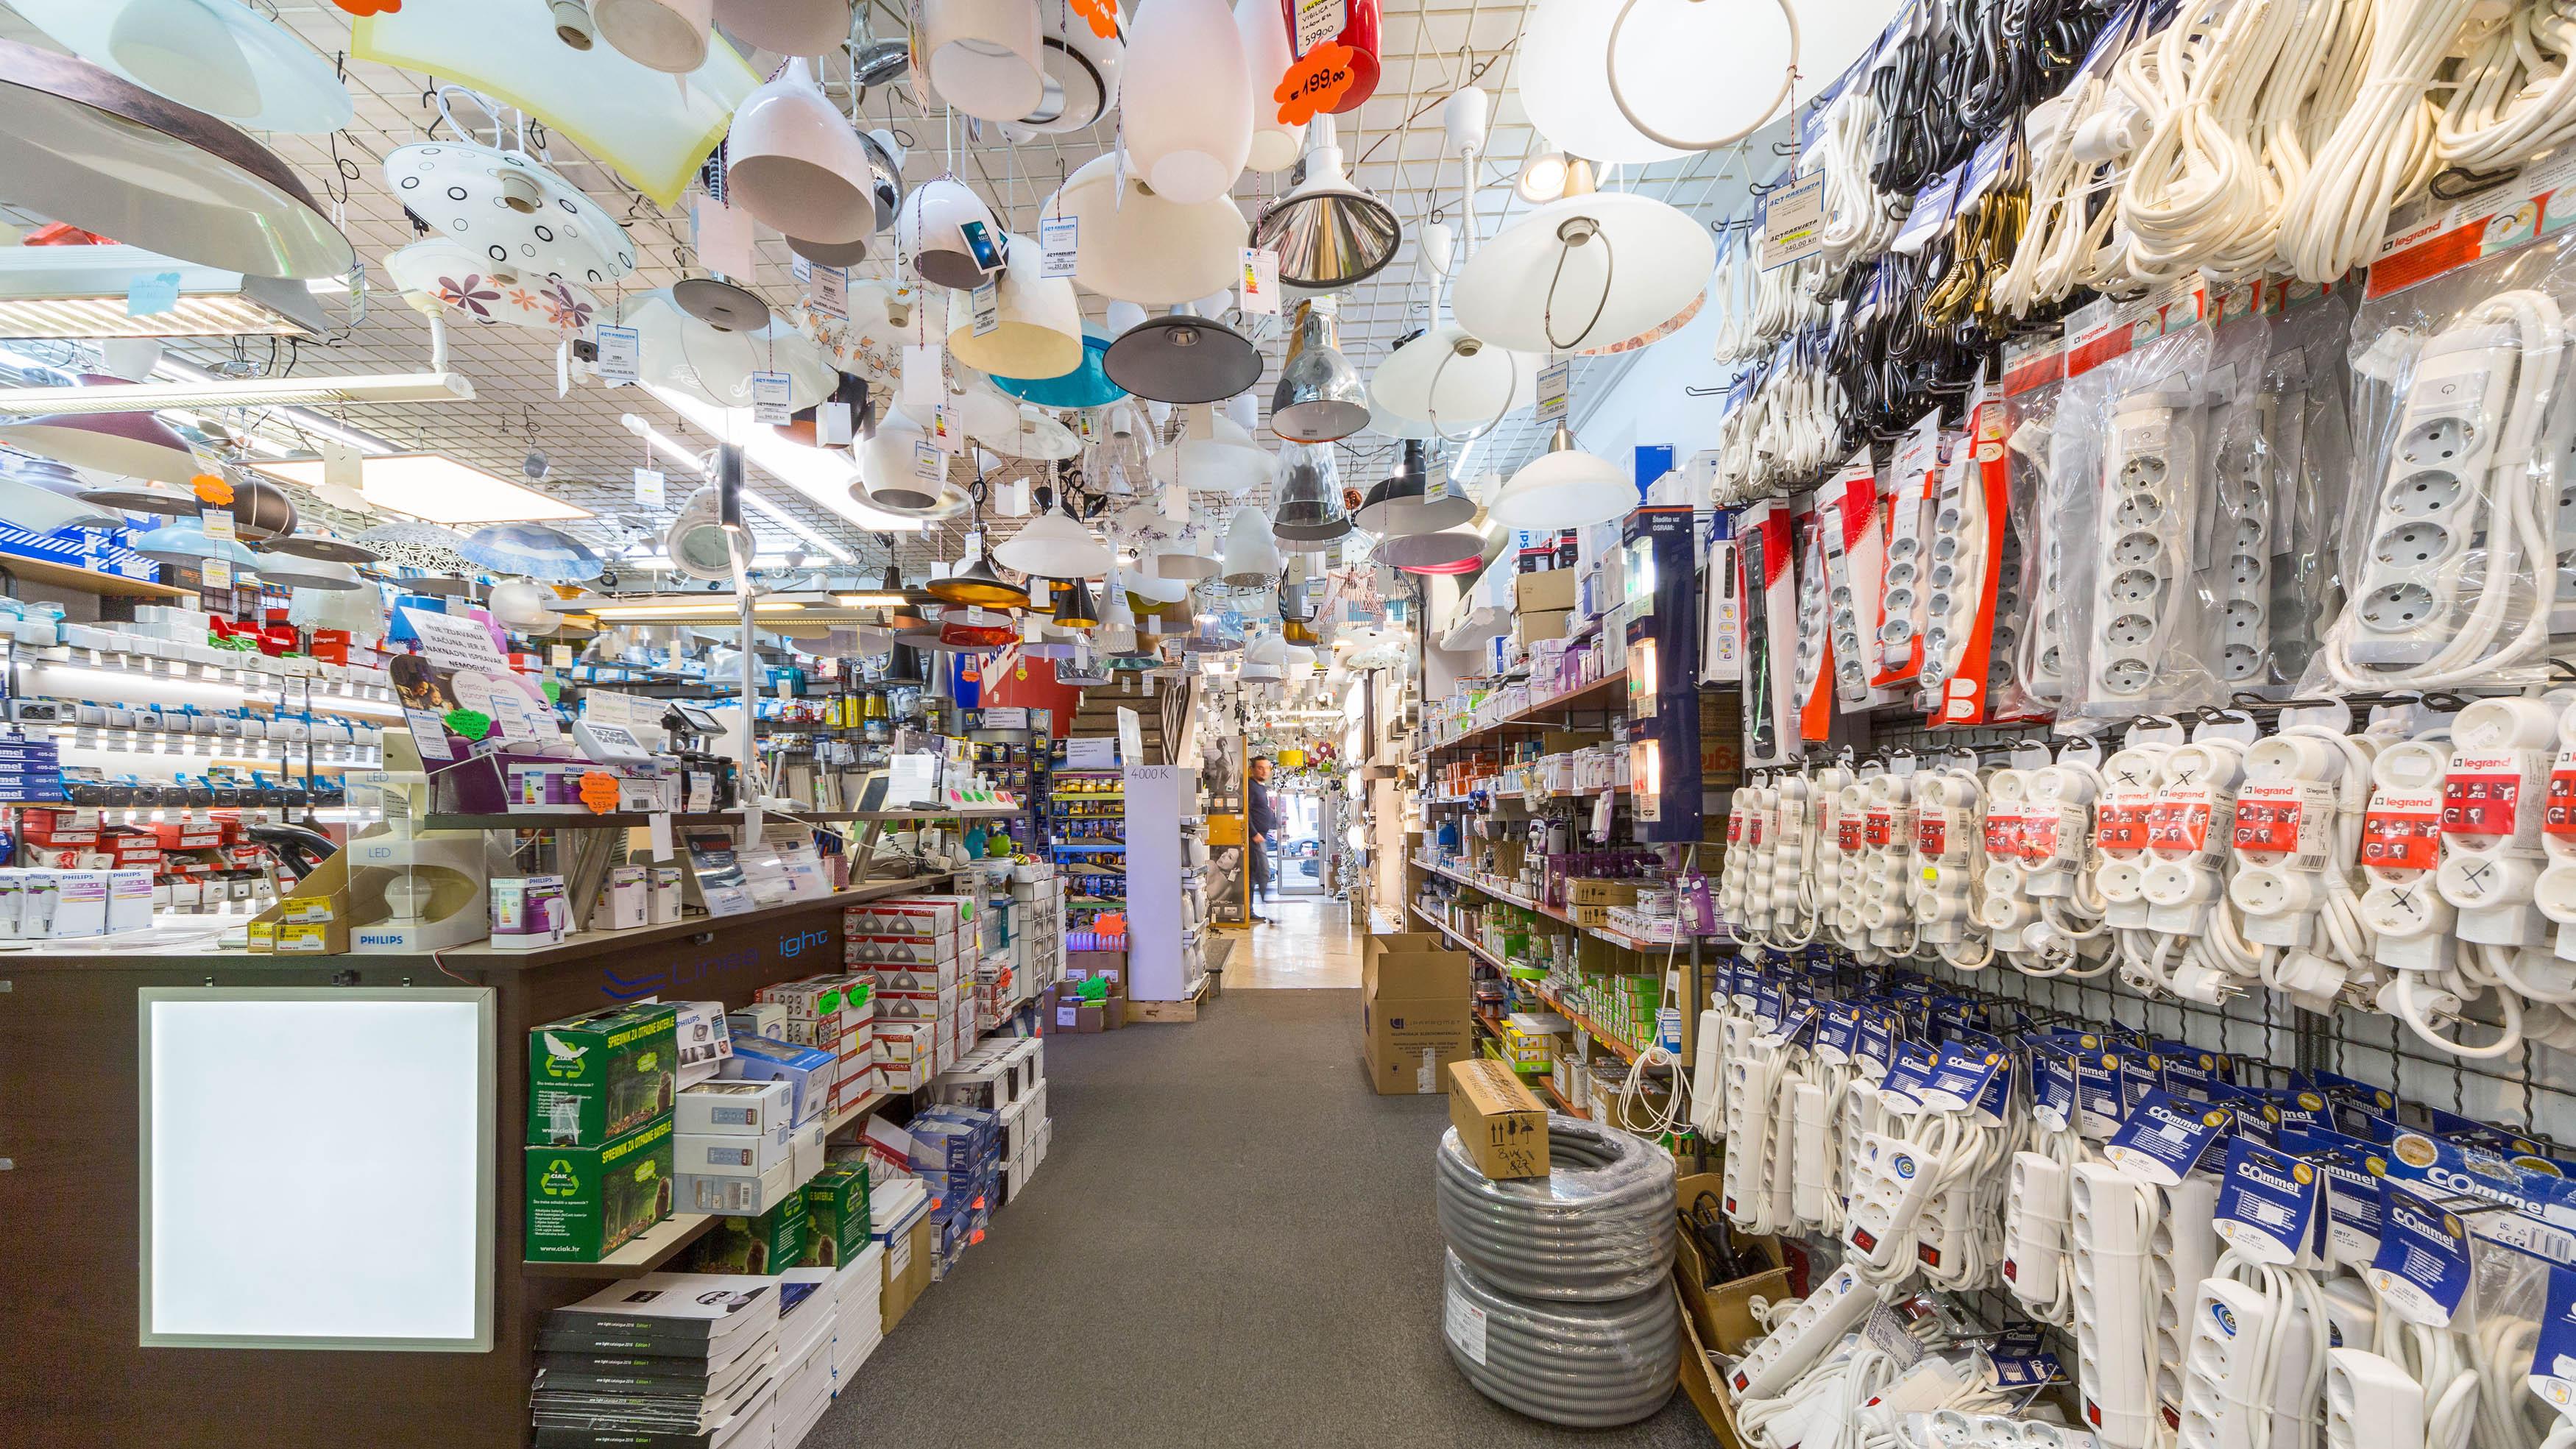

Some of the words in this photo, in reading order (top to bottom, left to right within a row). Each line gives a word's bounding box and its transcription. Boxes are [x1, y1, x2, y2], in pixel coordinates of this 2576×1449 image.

[2394, 220, 2441, 247] legrand
[2081, 323, 2108, 341] legrand
[2464, 757, 2511, 770] legrand
[367, 773, 389, 782] LED
[1131, 768, 1157, 779] 4000
[1160, 768, 1169, 779] K
[2117, 792, 2149, 801] egrand
[2169, 790, 2205, 799] legrand
[2254, 786, 2293, 796] legrand
[2386, 797, 2433, 809] legrand
[369, 847, 391, 858] LED
[528, 876, 553, 885] PHILIPS
[360, 935, 403, 945] PHILIPS
[676, 1015, 701, 1028] PHILIPS
[608, 1032, 631, 1049] SPREMNIK
[631, 1029, 637, 1041] ZA
[637, 1023, 656, 1038] OTPADNE
[657, 1016, 675, 1031] BATERIJE
[602, 1145, 627, 1164] SPREMNIK
[628, 1139, 634, 1152] ZA
[634, 1131, 654, 1149] OTPADNE
[654, 1120, 672, 1141] BATERIJE
